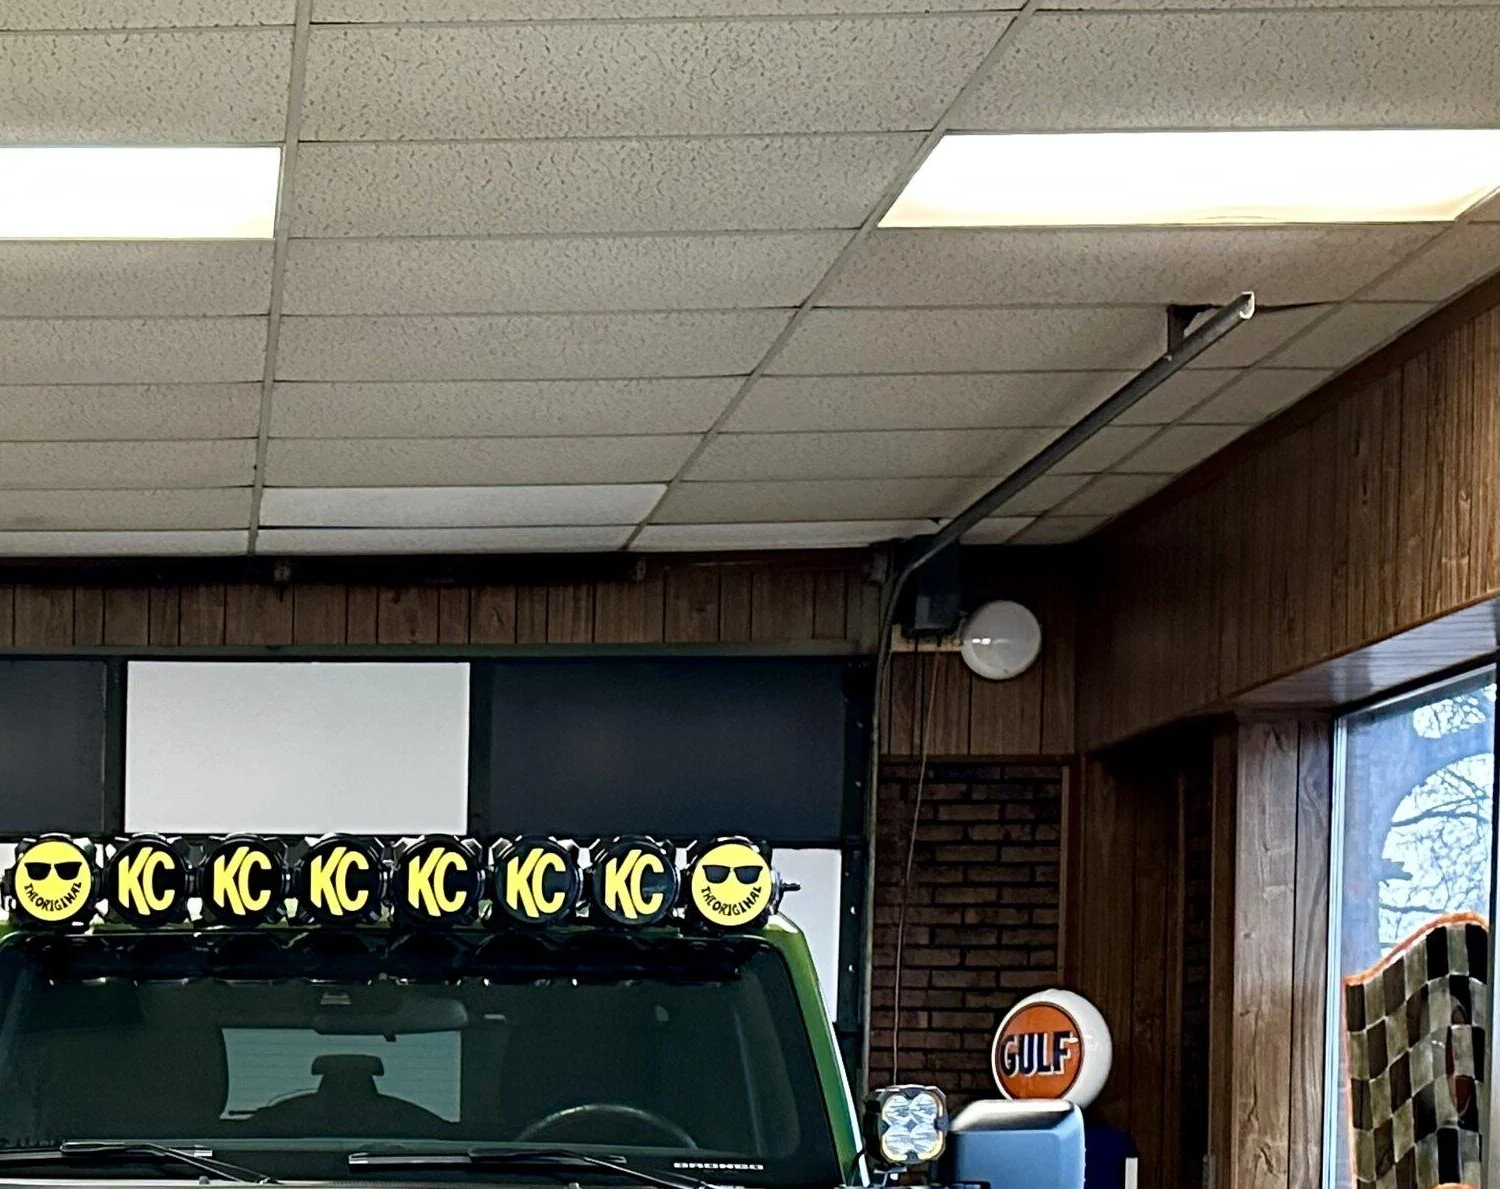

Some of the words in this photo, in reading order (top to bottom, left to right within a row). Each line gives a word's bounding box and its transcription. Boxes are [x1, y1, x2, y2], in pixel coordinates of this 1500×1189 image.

[35, 881, 82, 912] ORIGINAL
[118, 847, 176, 915] KC
[213, 847, 272, 916] KC
[310, 847, 369, 916] KC
[408, 847, 468, 917] KC
[506, 848, 566, 918] KC
[605, 849, 665, 919] KC
[712, 886, 762, 916] ORIGINAL
[1000, 1031, 1074, 1077] GULF
